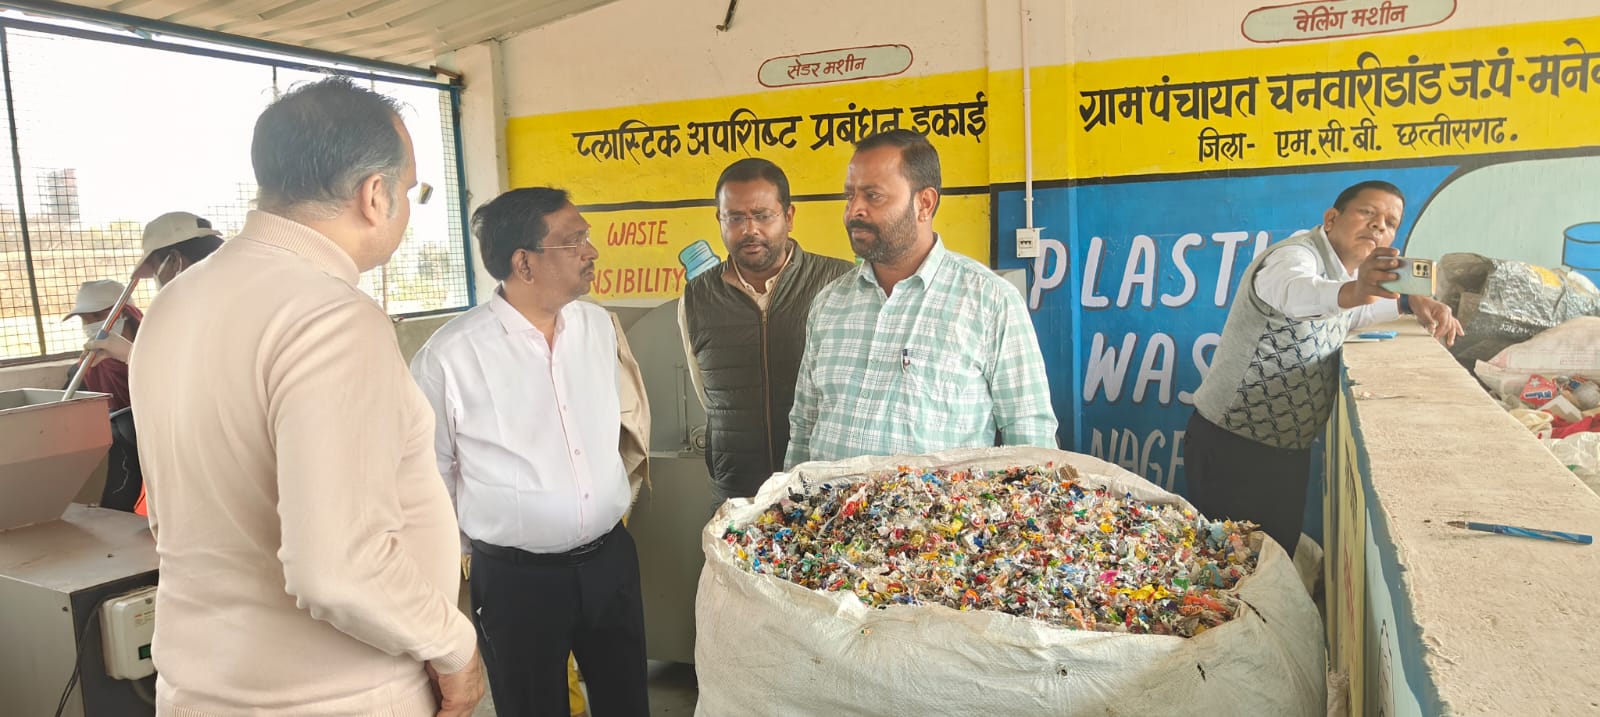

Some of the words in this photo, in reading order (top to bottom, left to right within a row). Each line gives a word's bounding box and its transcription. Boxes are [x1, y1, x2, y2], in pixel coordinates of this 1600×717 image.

[1352, 0, 1408, 27] मशीन
[787, 58, 820, 79] सेडर
[823, 53, 866, 75] मशीन
[1079, 86, 1143, 132] ग्राम
[1145, 75, 1260, 122] पंचायत
[1266, 51, 1446, 117] चनवारीडांड
[572, 119, 681, 165] प्लास्टिक
[687, 108, 803, 157] अपशिष्ट
[809, 102, 903, 150] प्रबंधन
[607, 220, 668, 246] WASTE
[592, 267, 685, 294] NSIBILITY
[1083, 332, 1222, 404] WAS
